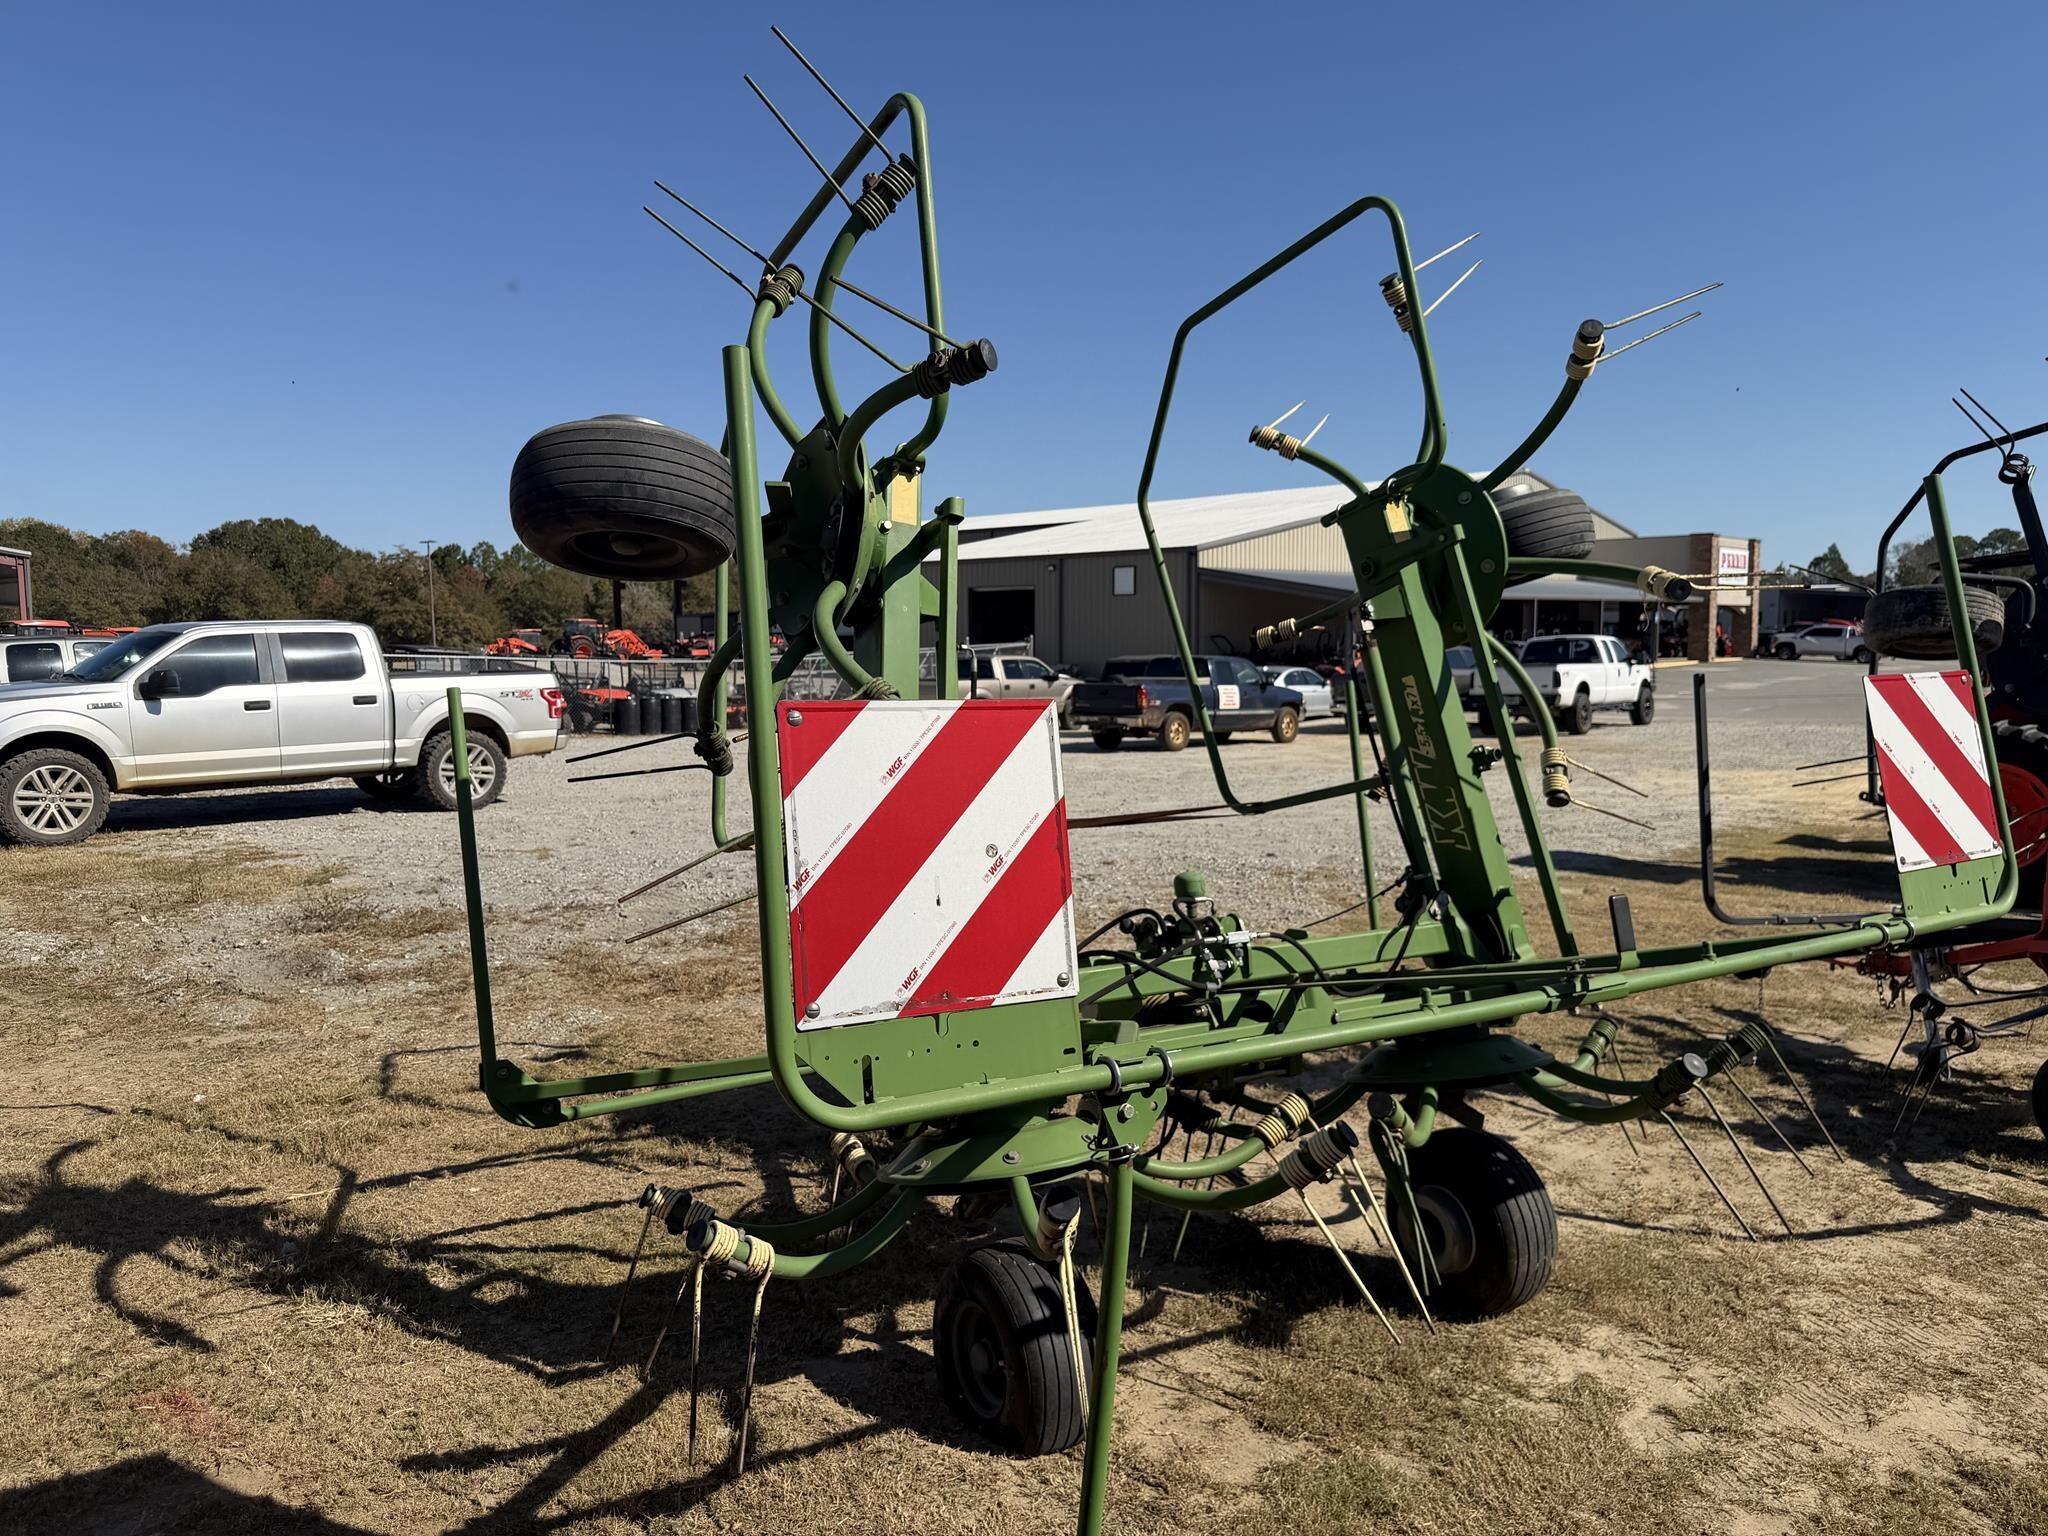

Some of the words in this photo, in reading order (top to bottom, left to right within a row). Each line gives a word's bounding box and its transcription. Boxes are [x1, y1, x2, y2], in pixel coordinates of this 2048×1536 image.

[886, 756, 904, 778] WGF
[988, 854, 1004, 876] WGF
[792, 868, 811, 891] WGF
[901, 966, 919, 990] WGF
